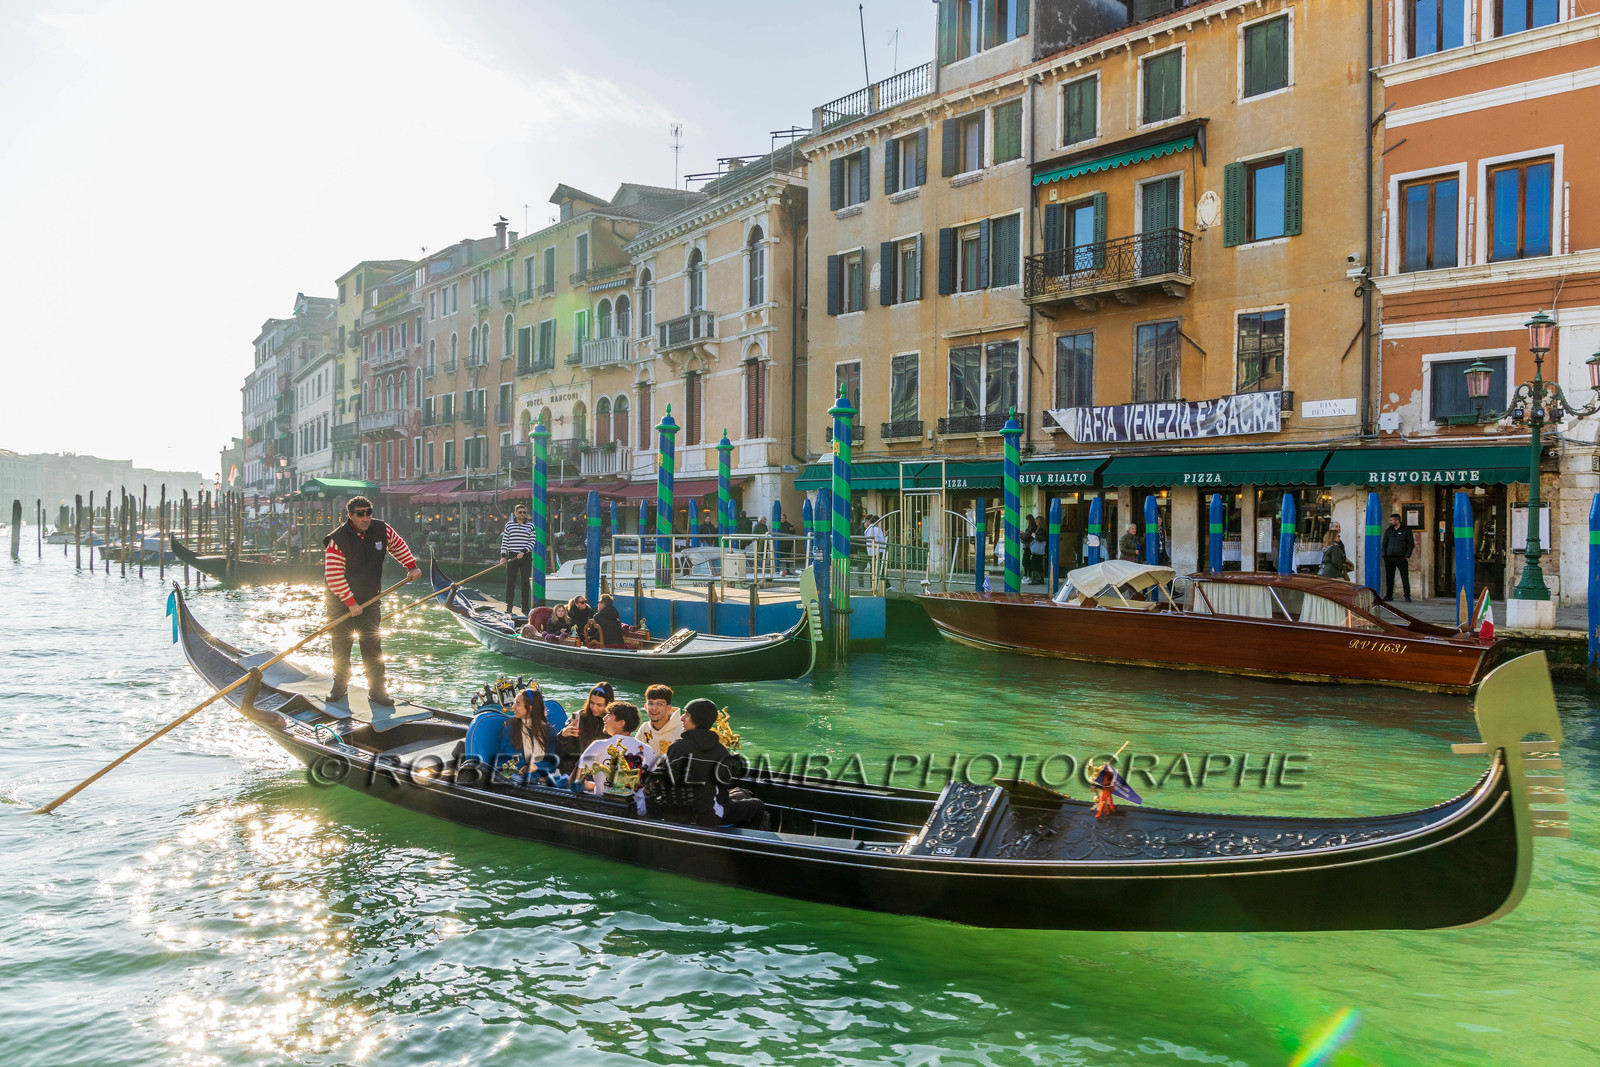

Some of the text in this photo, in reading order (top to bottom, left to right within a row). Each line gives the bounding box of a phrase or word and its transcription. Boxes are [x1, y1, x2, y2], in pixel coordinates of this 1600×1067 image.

[550, 392, 579, 402] MARCONI
[1124, 402, 1193, 441] VENEZIA
[1215, 391, 1278, 435] SACRA
[1019, 473, 1087, 483] RIVA RIALTO
[1183, 473, 1222, 483] PIZZA
[1368, 470, 1480, 482] RISTORANTE
